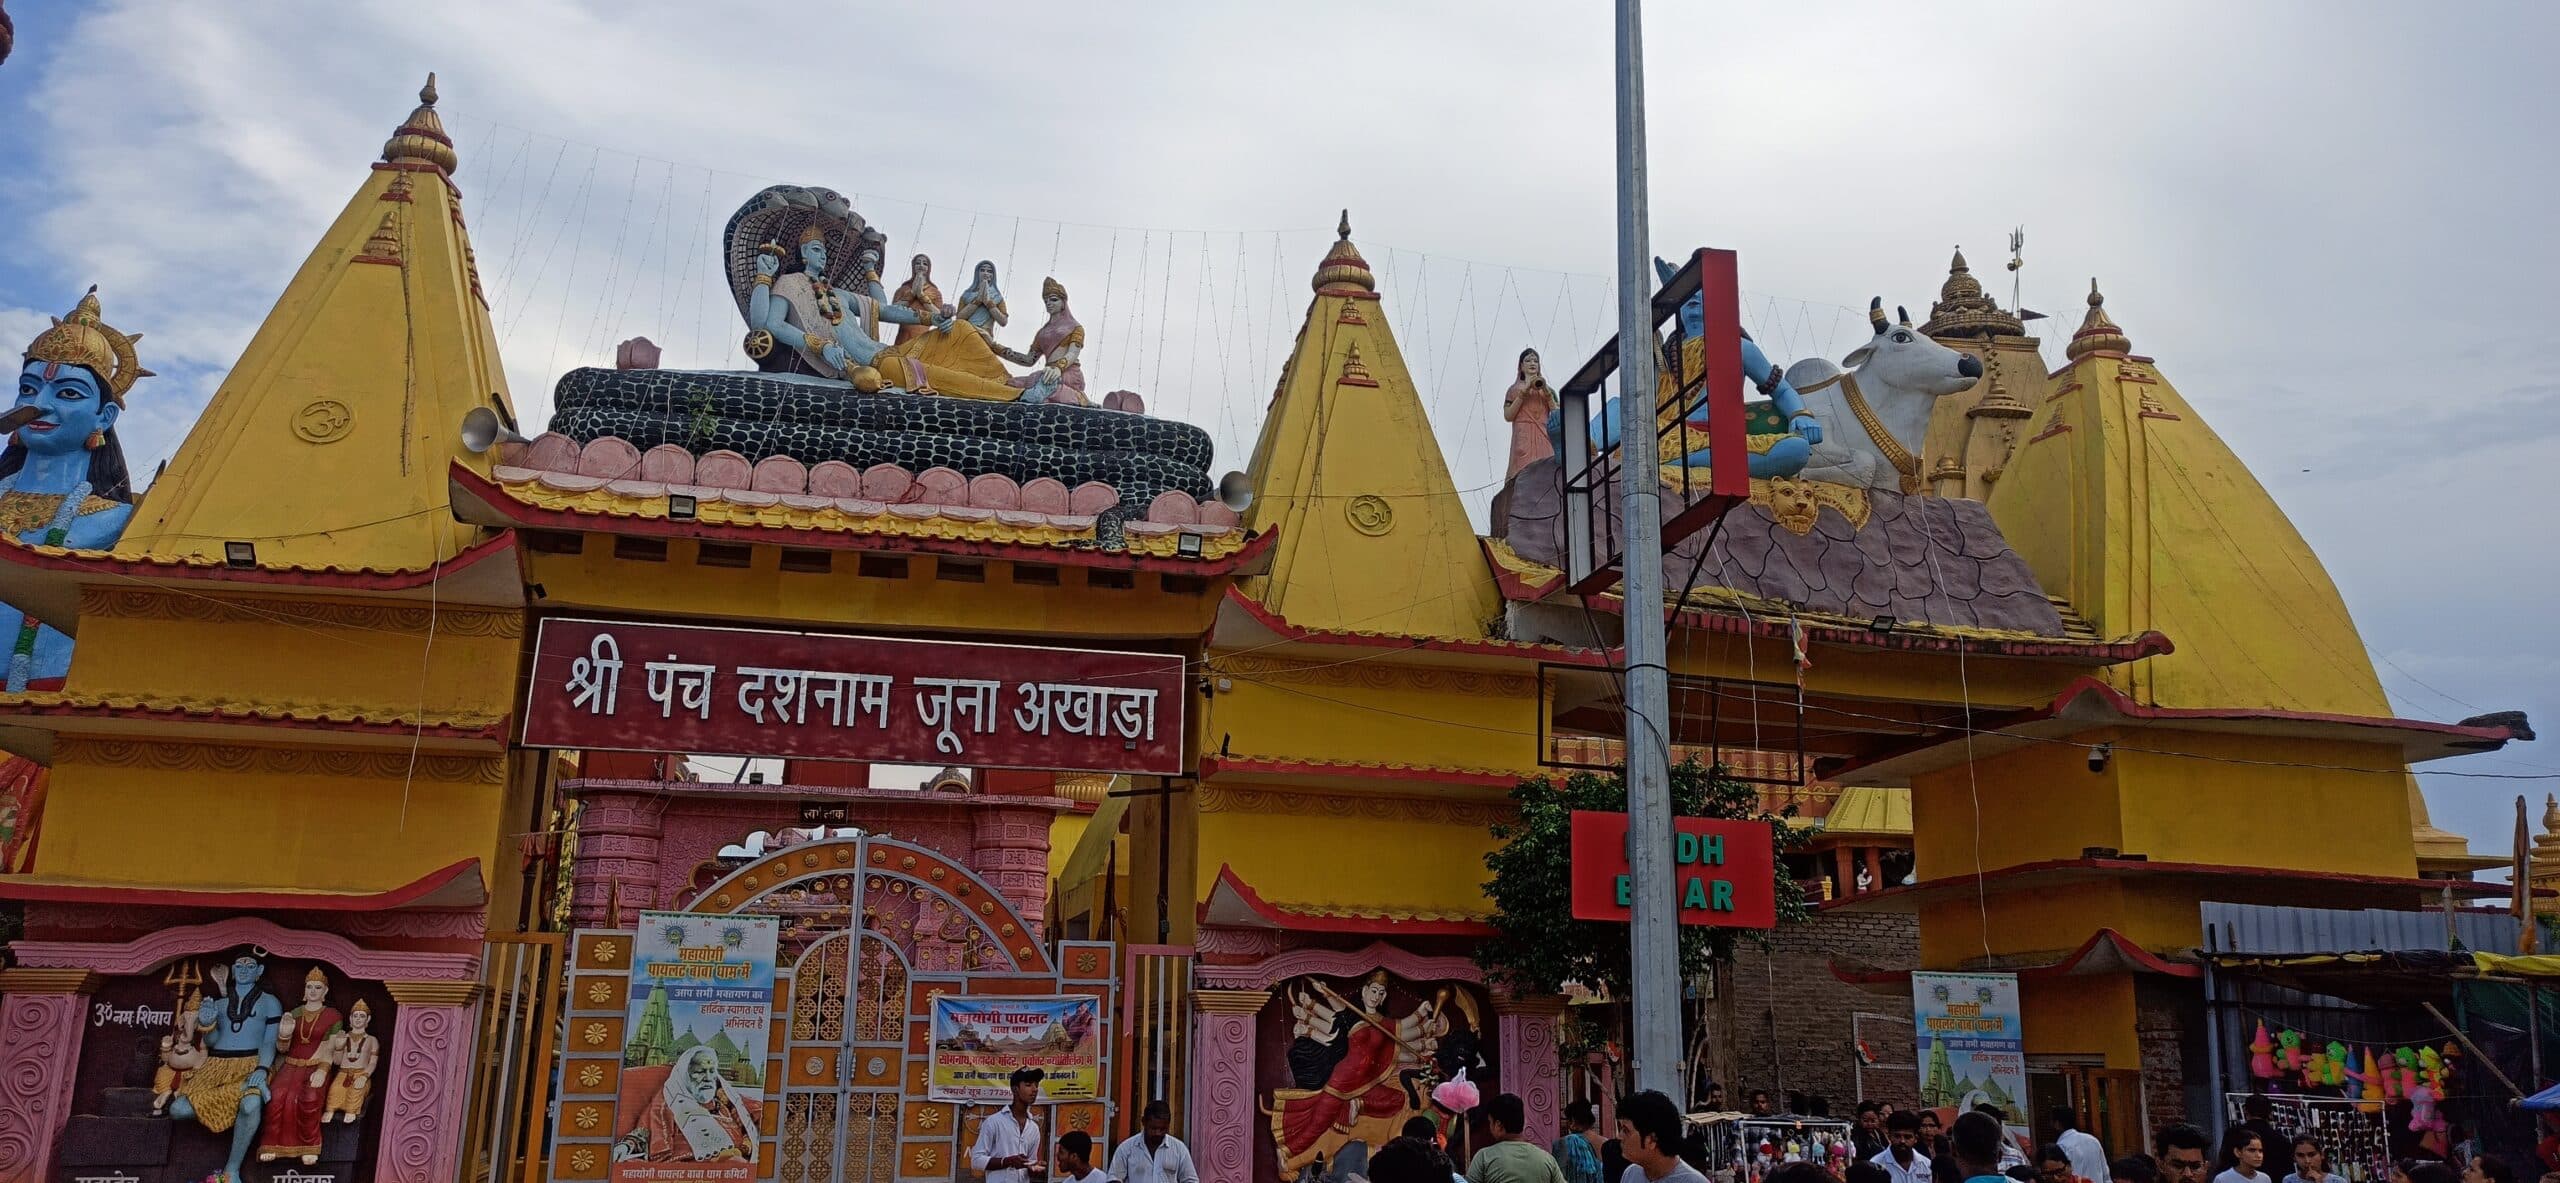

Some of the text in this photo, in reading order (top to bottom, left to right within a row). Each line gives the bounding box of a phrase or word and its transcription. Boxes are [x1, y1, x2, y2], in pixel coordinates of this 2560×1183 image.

[565, 633, 1158, 755] श्री पंच दशनाम जूना अखाड़ा
[679, 944, 726, 962] महायोगी
[94, 1001, 113, 1027] ॐ
[136, 1005, 174, 1029] शिवाय
[950, 1009, 1049, 1025] महायोगी पायलट
